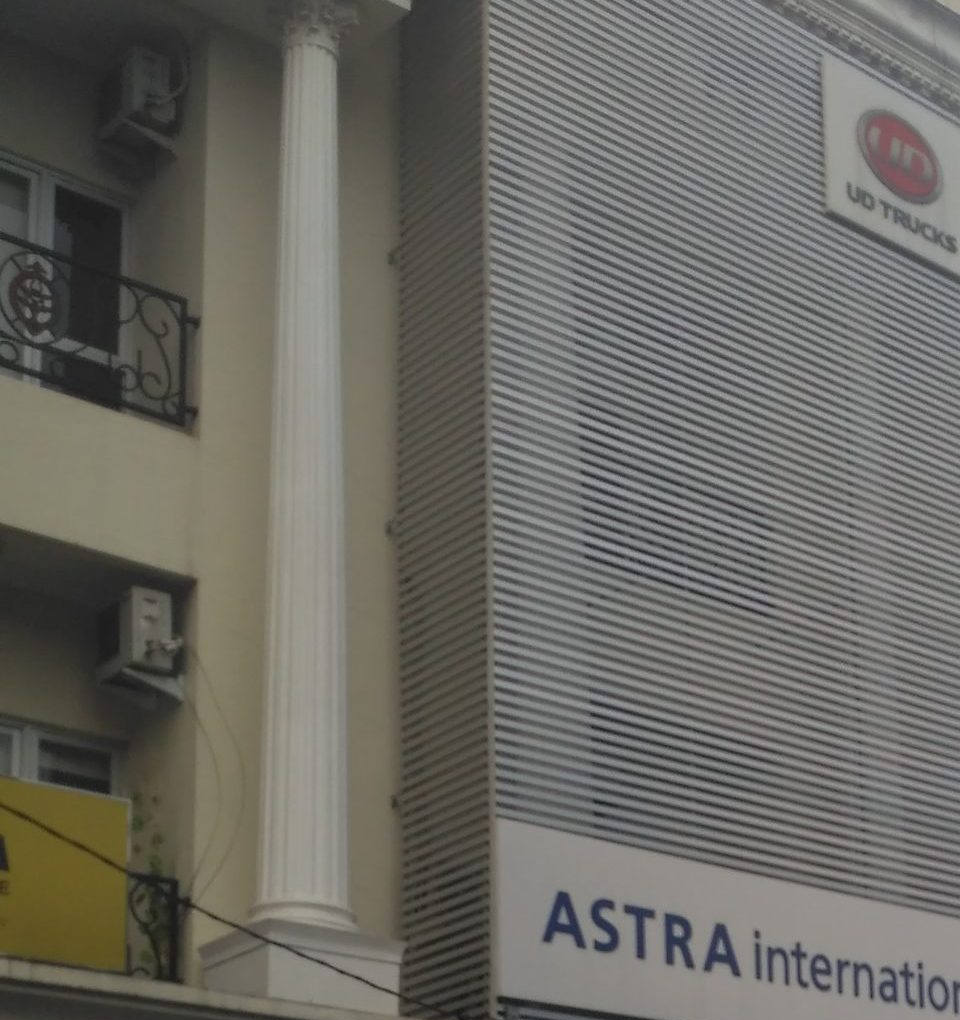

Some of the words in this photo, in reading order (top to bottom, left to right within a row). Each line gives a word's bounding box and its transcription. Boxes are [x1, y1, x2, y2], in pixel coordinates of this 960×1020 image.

[846, 182, 876, 211] UD
[879, 199, 958, 254] TRUCKS
[542, 891, 741, 978] ASTRA
